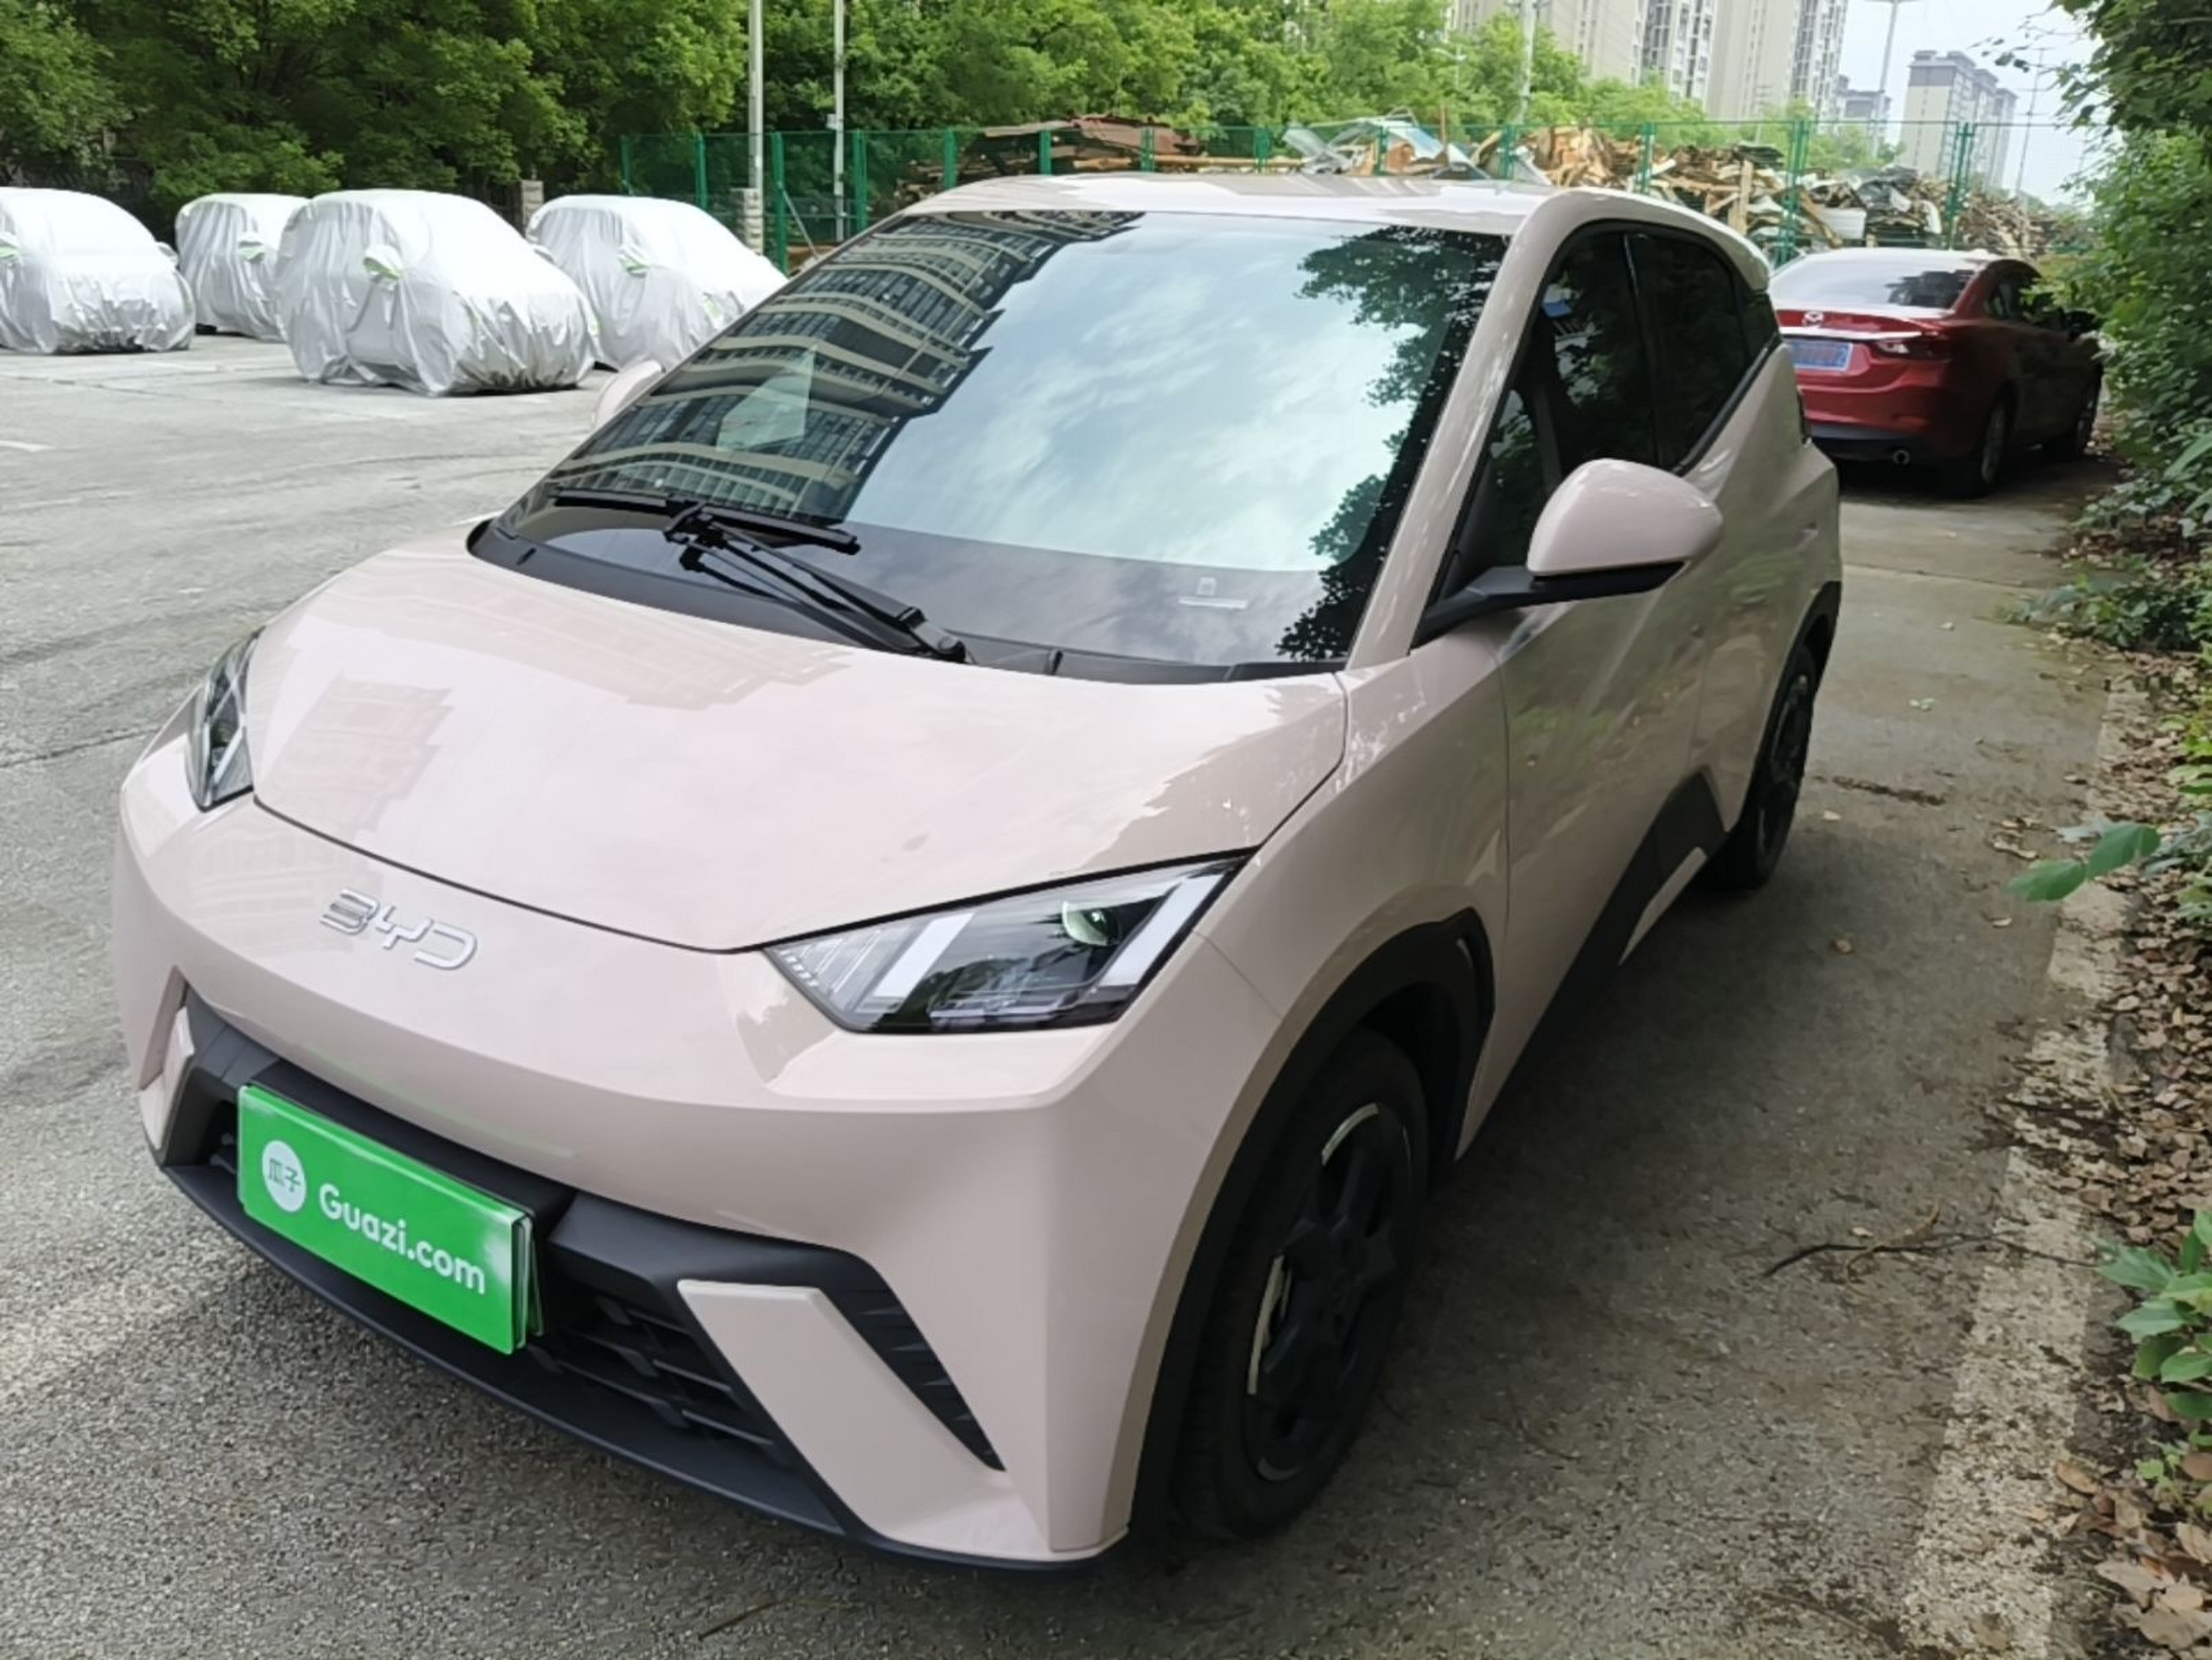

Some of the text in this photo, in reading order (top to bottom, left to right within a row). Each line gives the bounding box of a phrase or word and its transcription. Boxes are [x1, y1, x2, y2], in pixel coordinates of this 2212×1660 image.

[320, 888, 477, 970] BYD
[269, 1157, 301, 1192] 瓜子
[319, 1183, 485, 1294] Guazi.com
